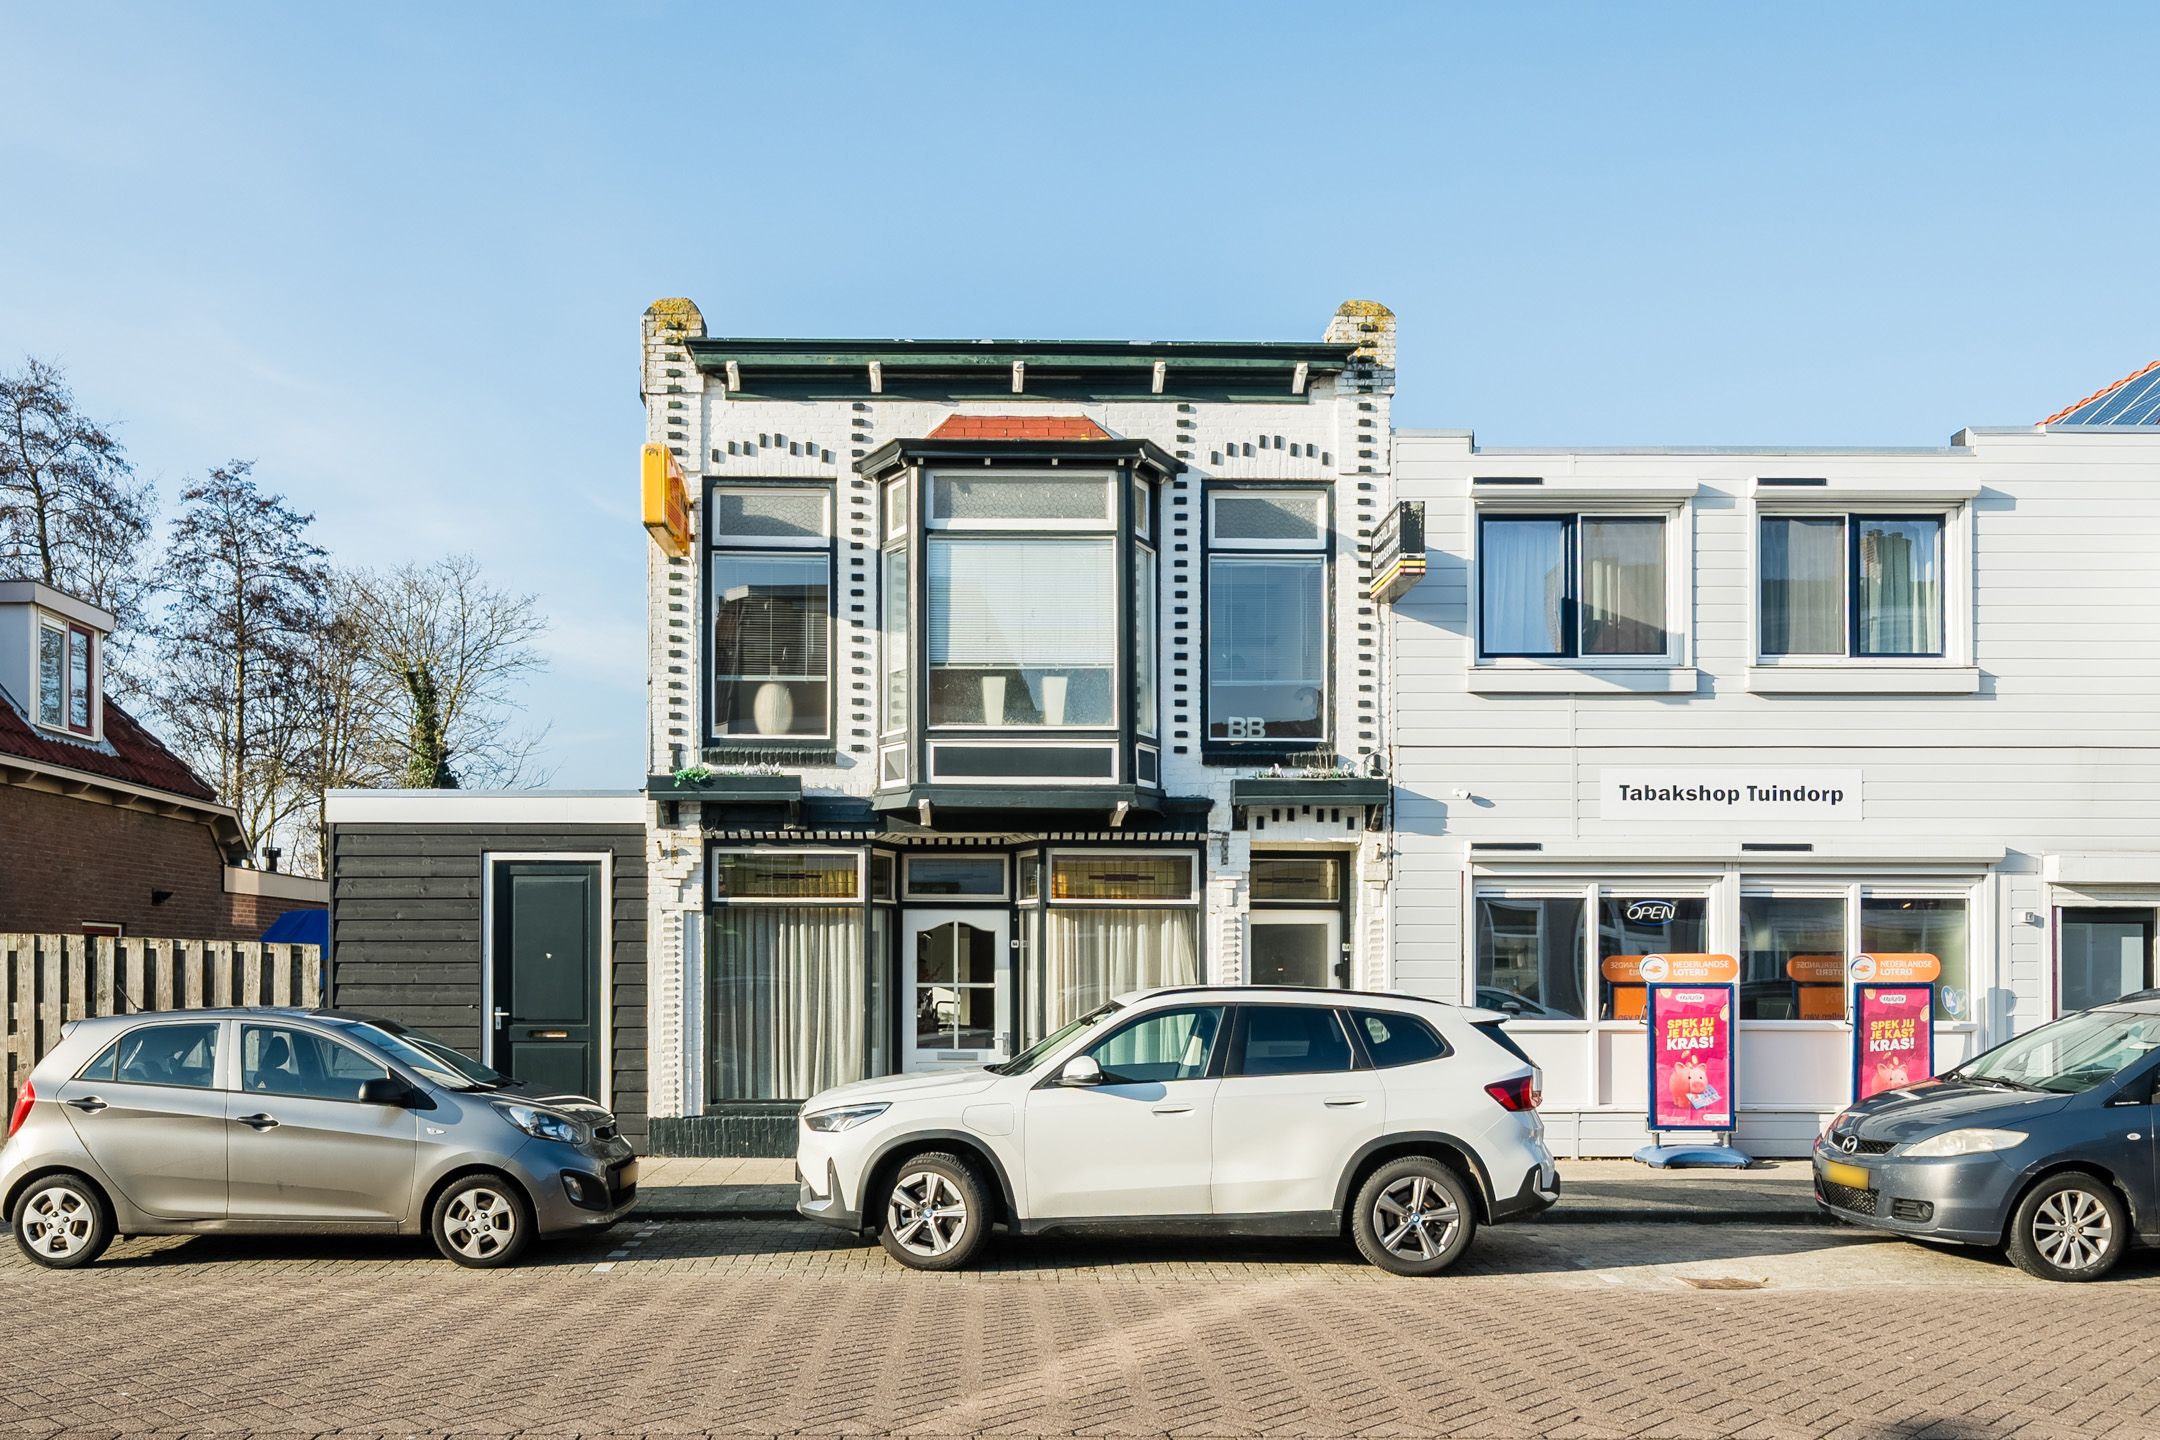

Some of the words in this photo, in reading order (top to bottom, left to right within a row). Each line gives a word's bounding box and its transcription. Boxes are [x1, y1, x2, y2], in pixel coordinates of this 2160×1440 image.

[1228, 716, 1266, 738] BB
[1619, 785, 1740, 805] Tabakshop
[1747, 785, 1844, 805] Tuindorp
[1627, 906, 1676, 920] OPEN
[1672, 960, 1729, 968] NEDERLANDSE
[1880, 960, 1933, 968] NEDERLANDSE
[1880, 968, 1913, 976] LOTERIJ
[1667, 1018, 1698, 1029] SPEK
[1700, 1017, 1714, 1027] JIJ
[1870, 1020, 1900, 1031] SPEK
[1901, 1018, 1915, 1028] JIJ
[1667, 1029, 1680, 1039] JE
[1682, 1027, 1714, 1037] KAS?
[1870, 1030, 1883, 1040] JE
[1885, 1028, 1915, 1039] KAS?
[1666, 1036, 1714, 1050] KRAS!
[1870, 1038, 1915, 1052] KRAS!
